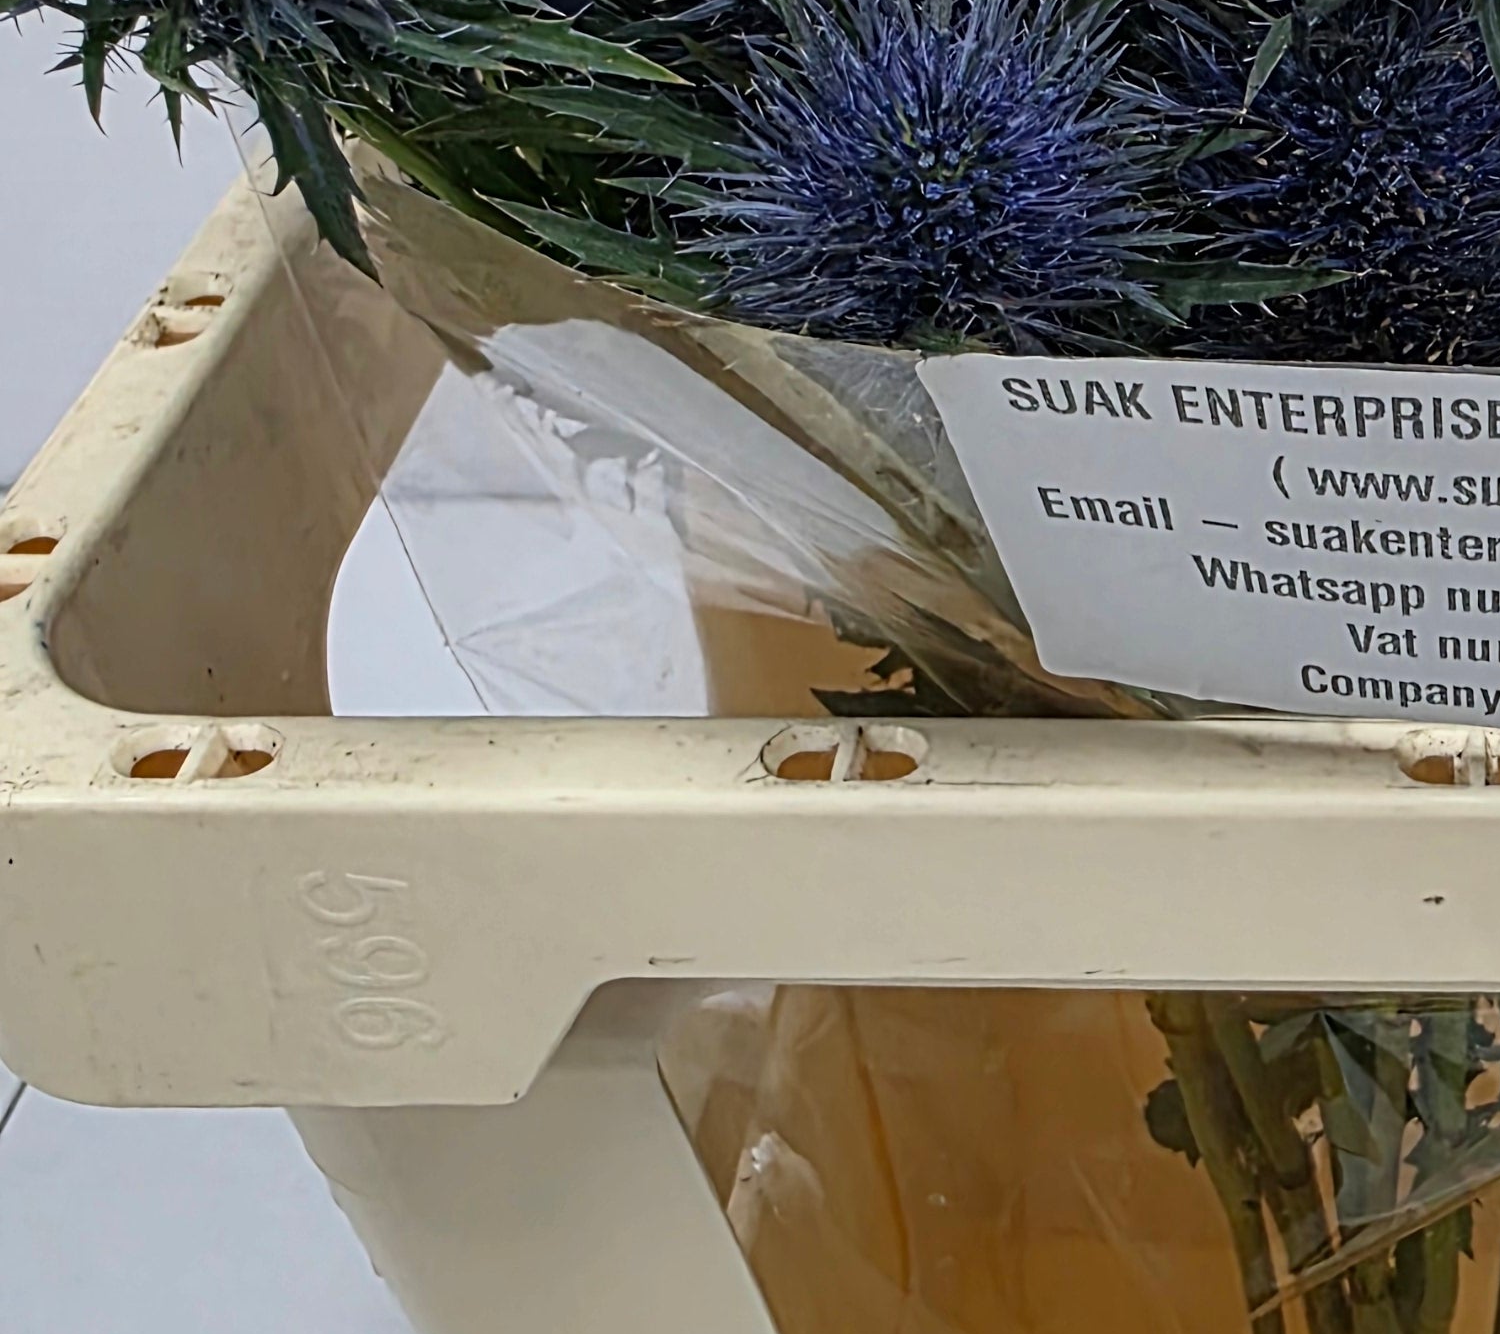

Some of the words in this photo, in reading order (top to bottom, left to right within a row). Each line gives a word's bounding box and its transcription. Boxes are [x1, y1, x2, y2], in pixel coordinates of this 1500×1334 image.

[1001, 377, 1153, 421] SUAK
[1038, 486, 1174, 531] Email
[1193, 554, 1426, 616] Whatsapp
[1348, 623, 1419, 658] Vat
